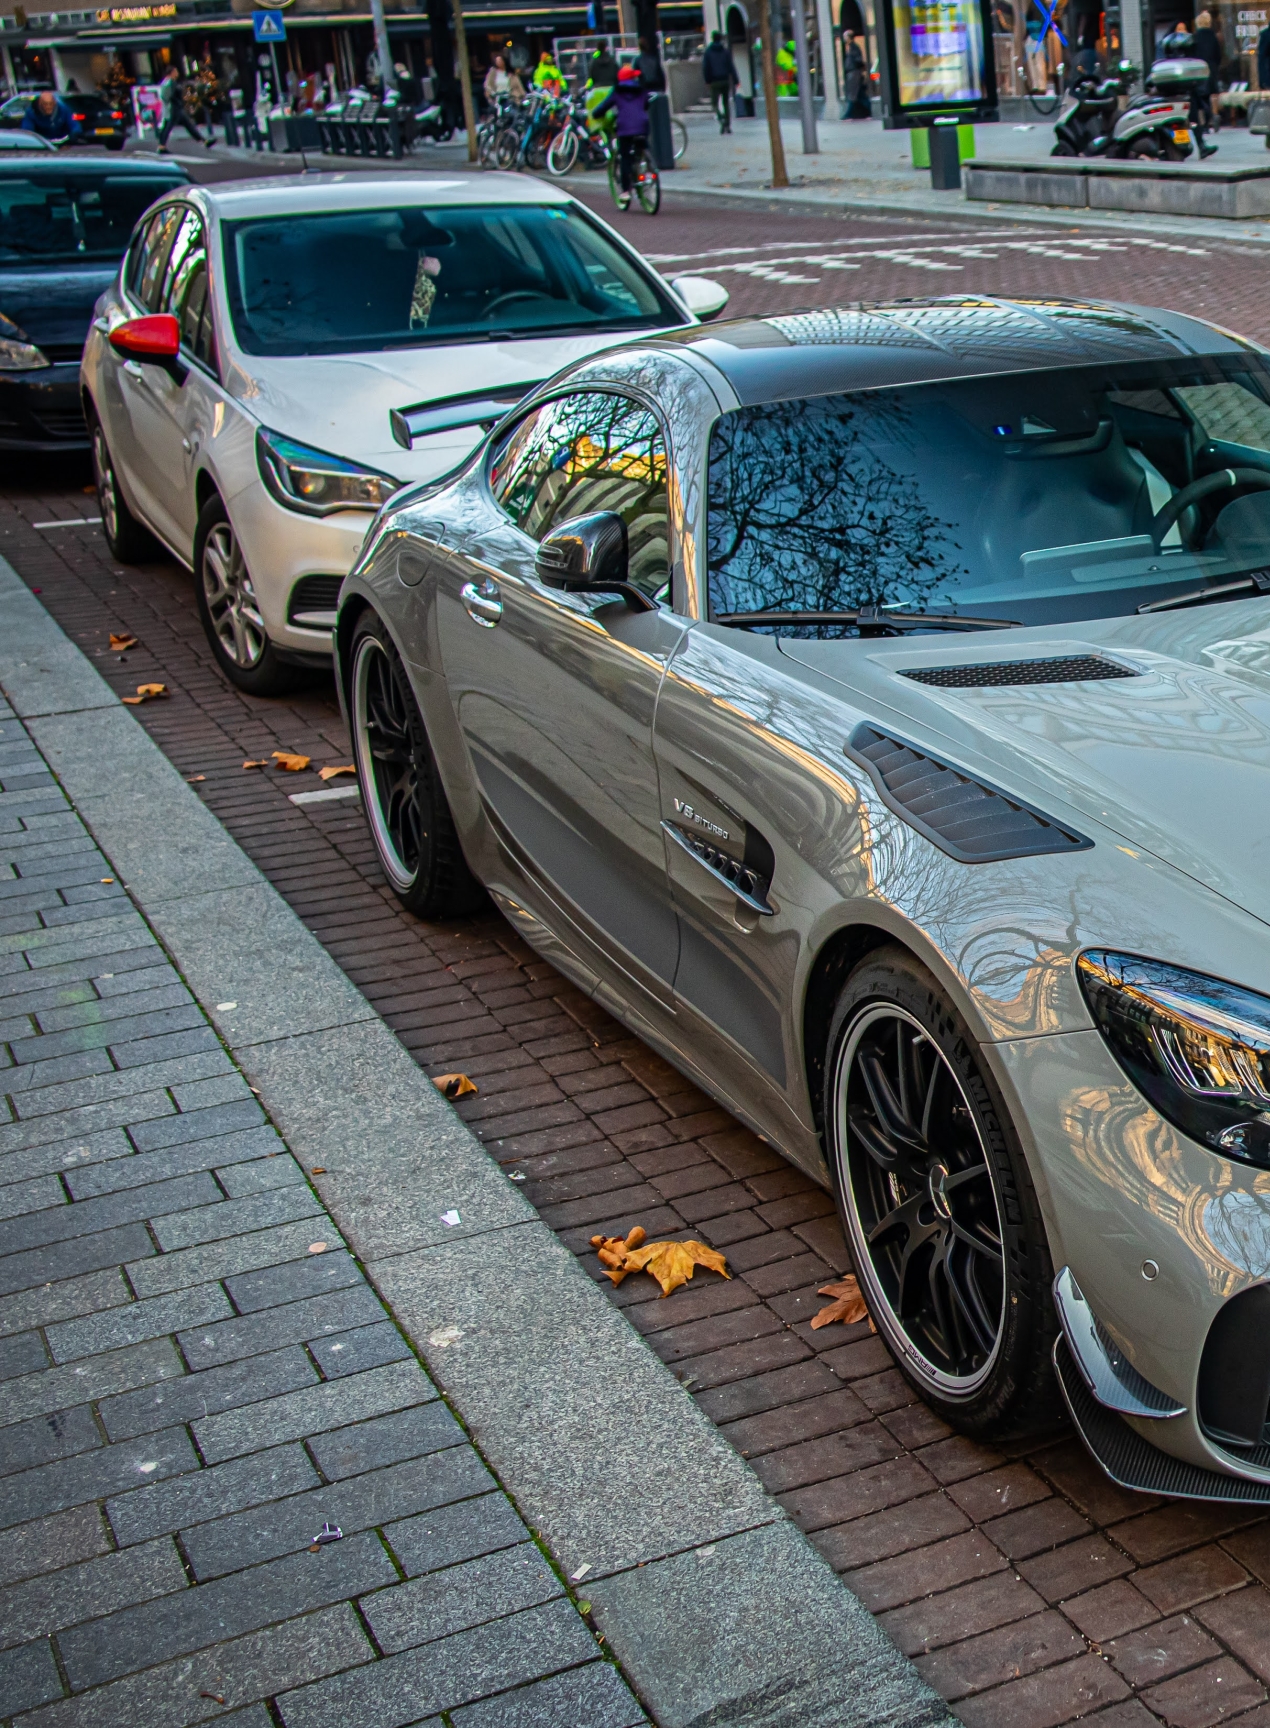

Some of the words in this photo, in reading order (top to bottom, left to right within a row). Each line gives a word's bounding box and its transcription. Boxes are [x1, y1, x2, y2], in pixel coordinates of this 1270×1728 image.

[674, 797, 694, 819] V8
[694, 814, 729, 840] BITURBO
[968, 1074, 1023, 1226] MICHELIN
